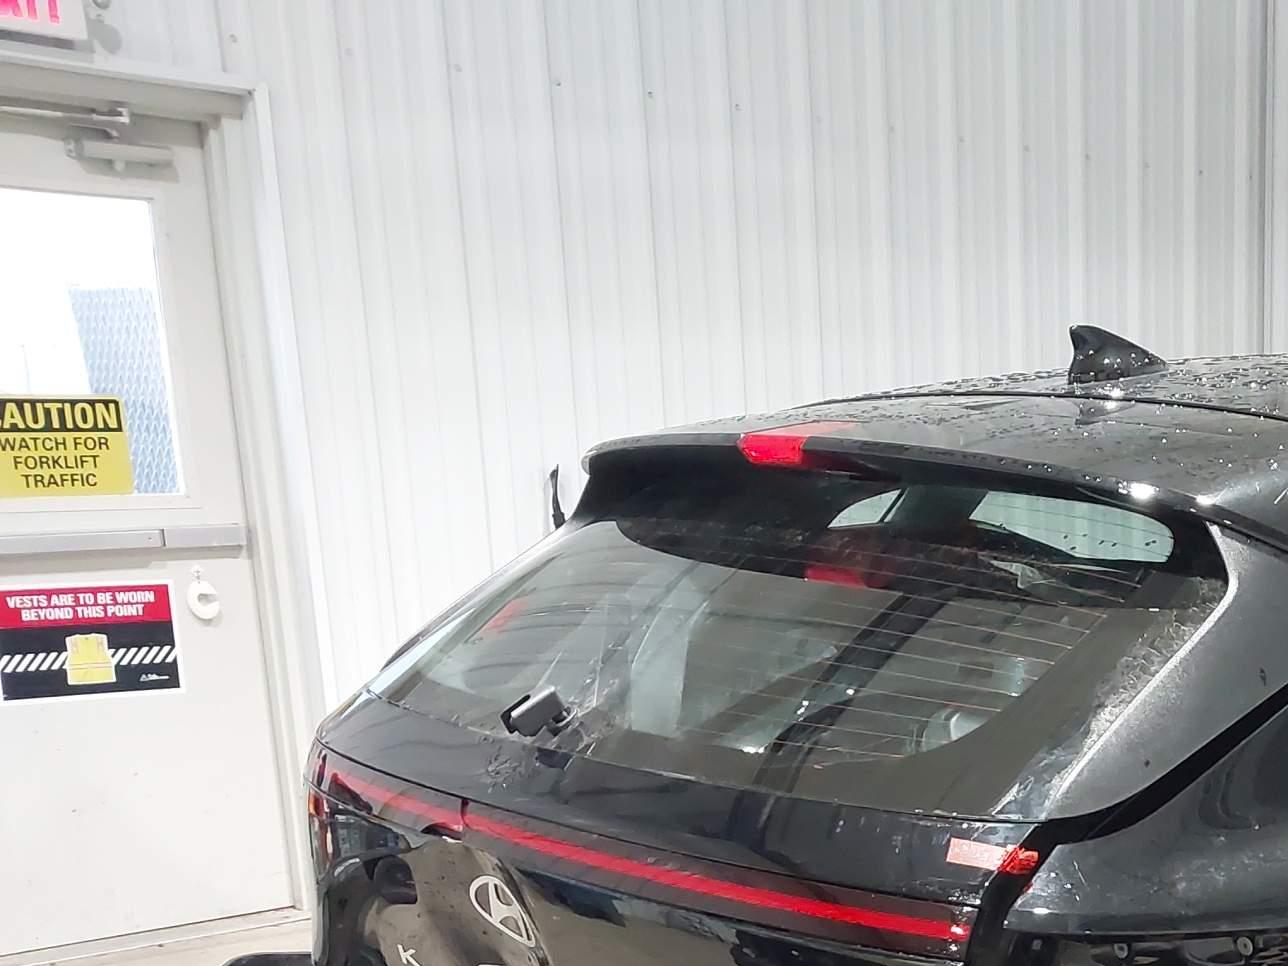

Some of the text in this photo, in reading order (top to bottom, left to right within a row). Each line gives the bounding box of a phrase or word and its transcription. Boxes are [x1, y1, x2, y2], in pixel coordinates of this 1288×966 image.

[0, 402, 119, 430] AUTION
[0, 436, 110, 451] WATCH FOR
[13, 454, 100, 470] FORKLIFT
[21, 473, 98, 488] TRAFFIC
[5, 590, 155, 609] VESTS ARE TO BE WORN
[21, 604, 144, 621] BEYOND THIS POINT
